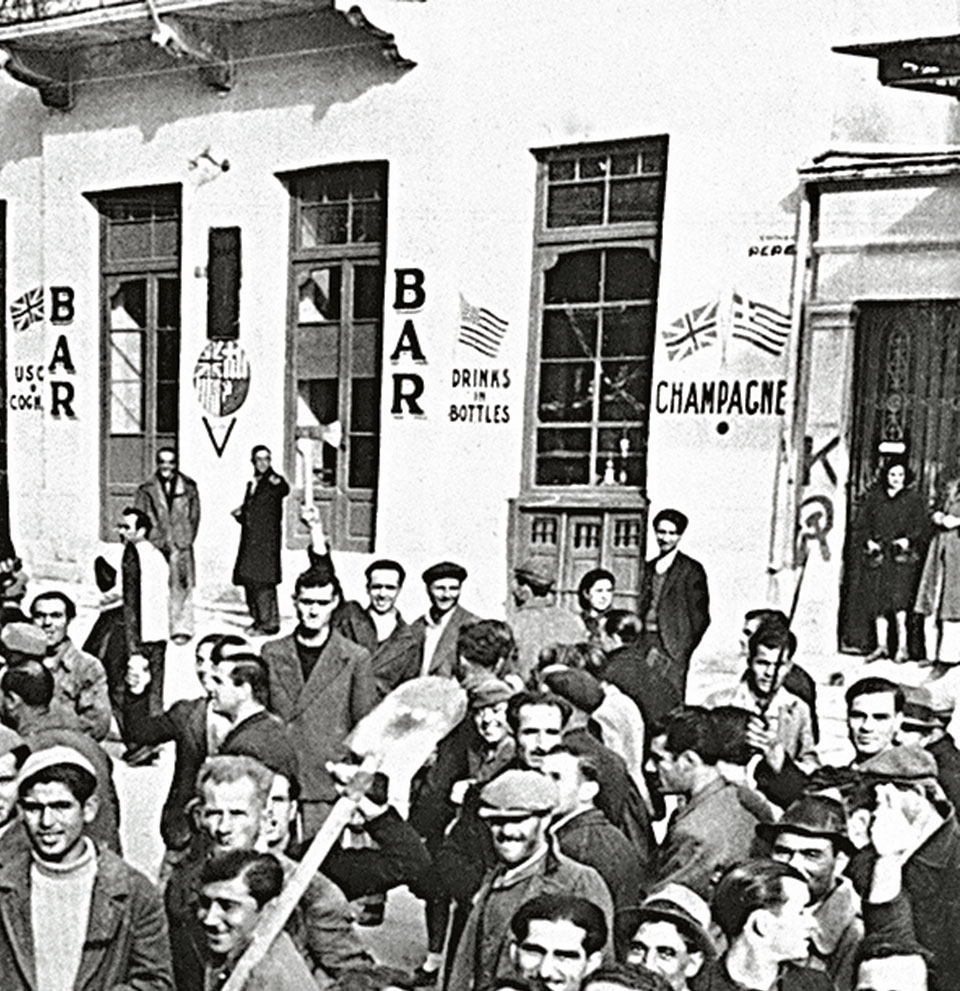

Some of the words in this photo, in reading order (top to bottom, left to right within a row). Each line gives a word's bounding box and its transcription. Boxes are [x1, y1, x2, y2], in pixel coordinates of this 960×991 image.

[47, 285, 78, 420] BAR
[390, 267, 428, 420] BAR
[452, 368, 511, 389] DRINKS
[473, 391, 486, 401] IN
[656, 379, 788, 416] CHAMPAGNE
[448, 404, 510, 424] BOTTLES
